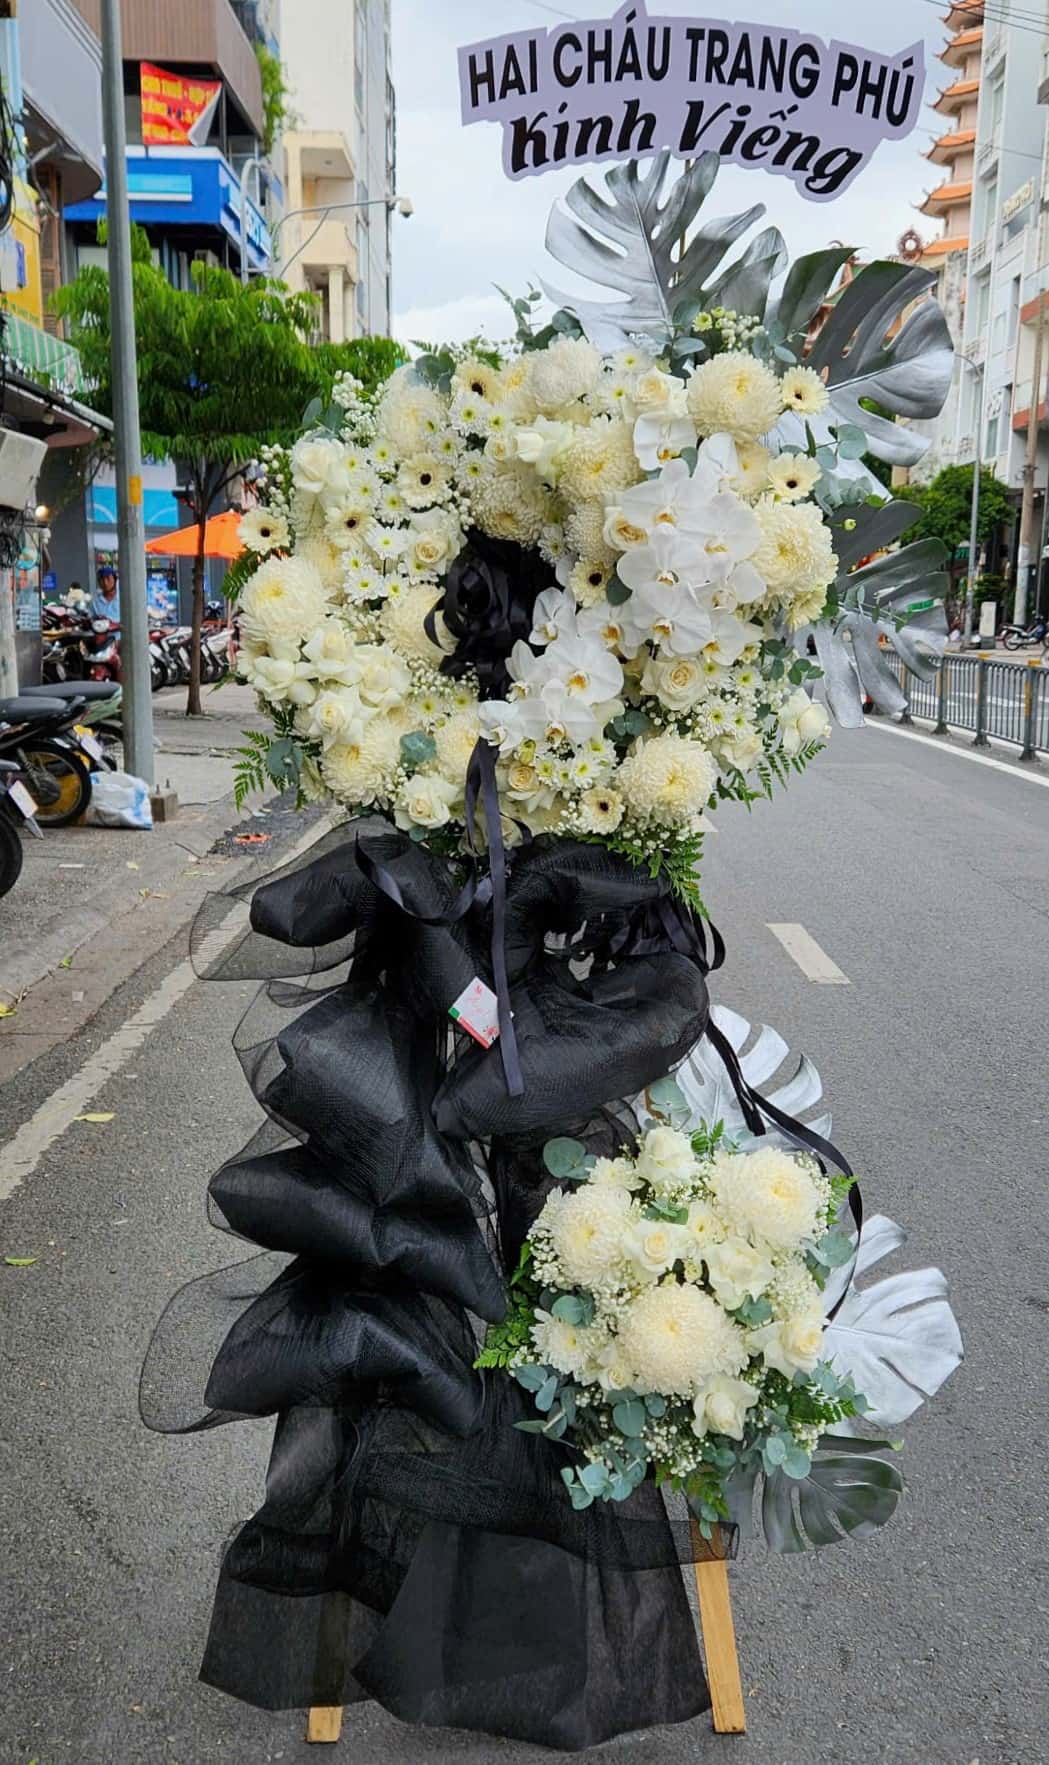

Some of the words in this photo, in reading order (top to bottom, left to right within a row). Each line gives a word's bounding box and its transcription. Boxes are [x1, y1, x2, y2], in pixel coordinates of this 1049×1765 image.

[468, 39, 539, 107] HAI
[553, 8, 671, 88] CHÁU
[686, 27, 821, 99] TRANG
[831, 53, 915, 127] PHÚ
[509, 98, 656, 173] Kính
[679, 100, 863, 194] Viếng
